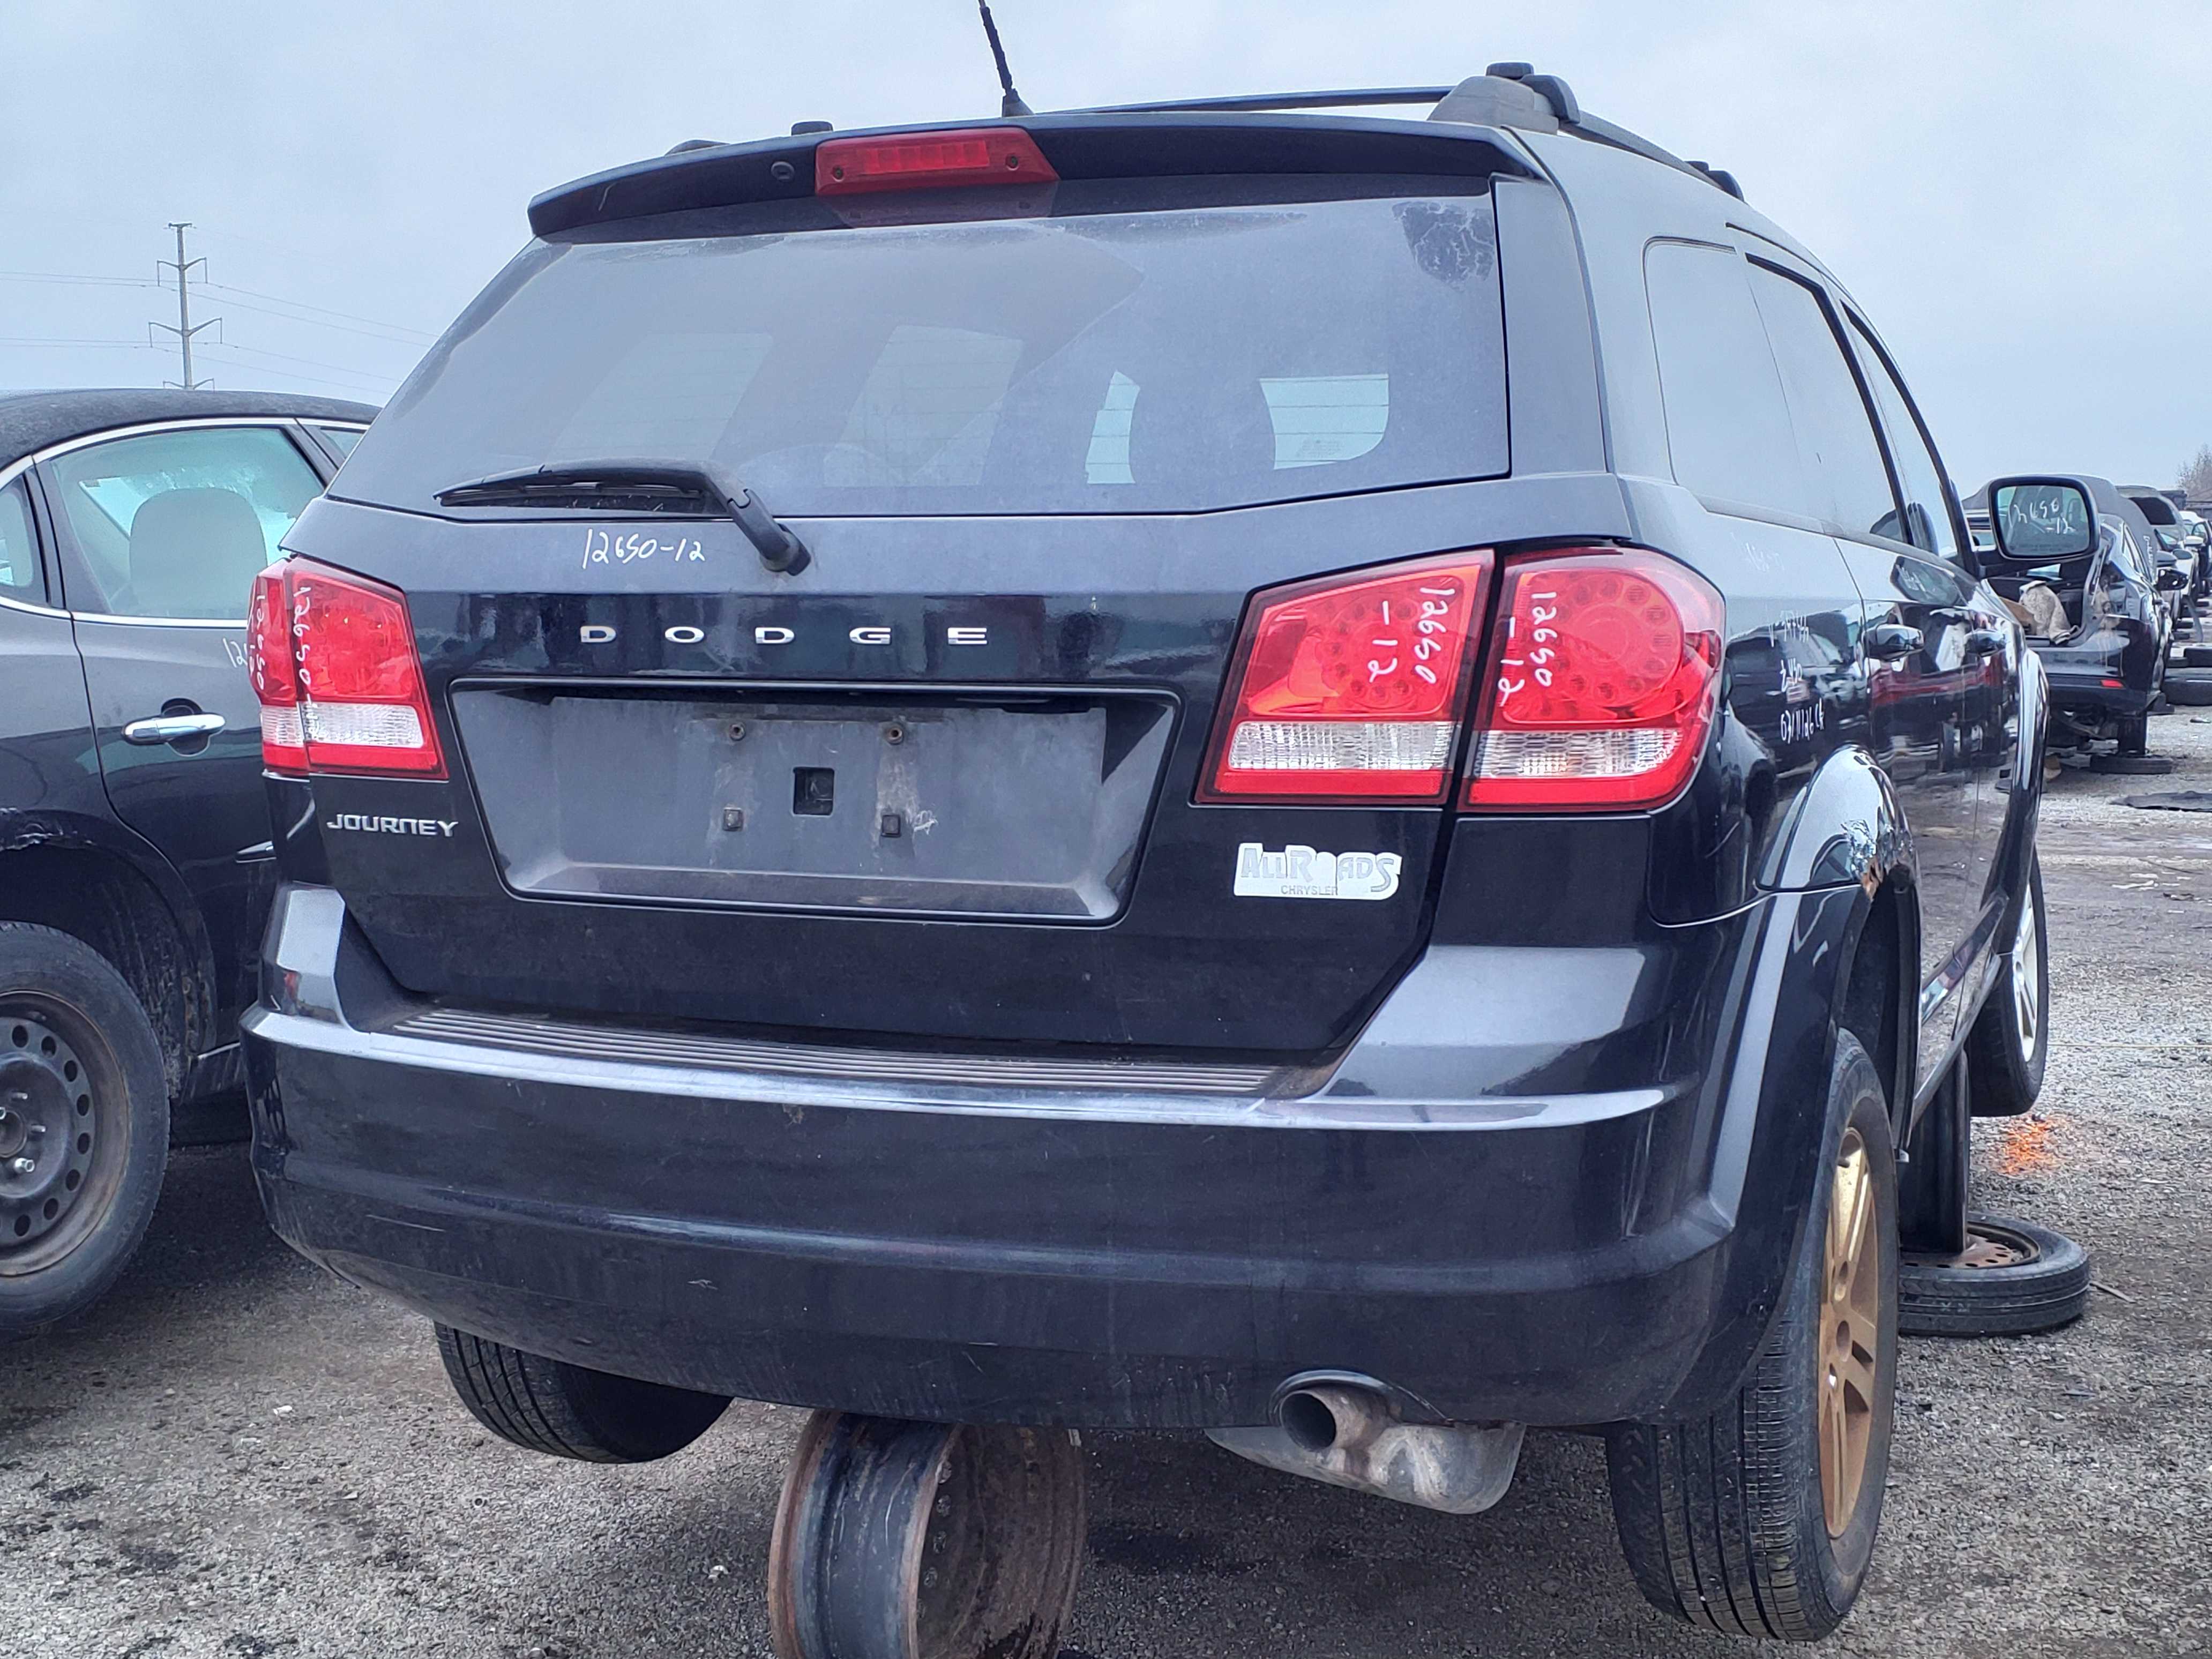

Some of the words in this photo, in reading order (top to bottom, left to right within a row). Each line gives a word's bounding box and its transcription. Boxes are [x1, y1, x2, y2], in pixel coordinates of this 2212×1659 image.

[582, 528, 706, 569] 12650-12
[580, 626, 988, 645] DODGE
[1414, 587, 1455, 684] 12650
[1529, 592, 1558, 686] 12650
[326, 814, 459, 837] JOURNEY
[1281, 884, 1338, 895] CHRYSLER
